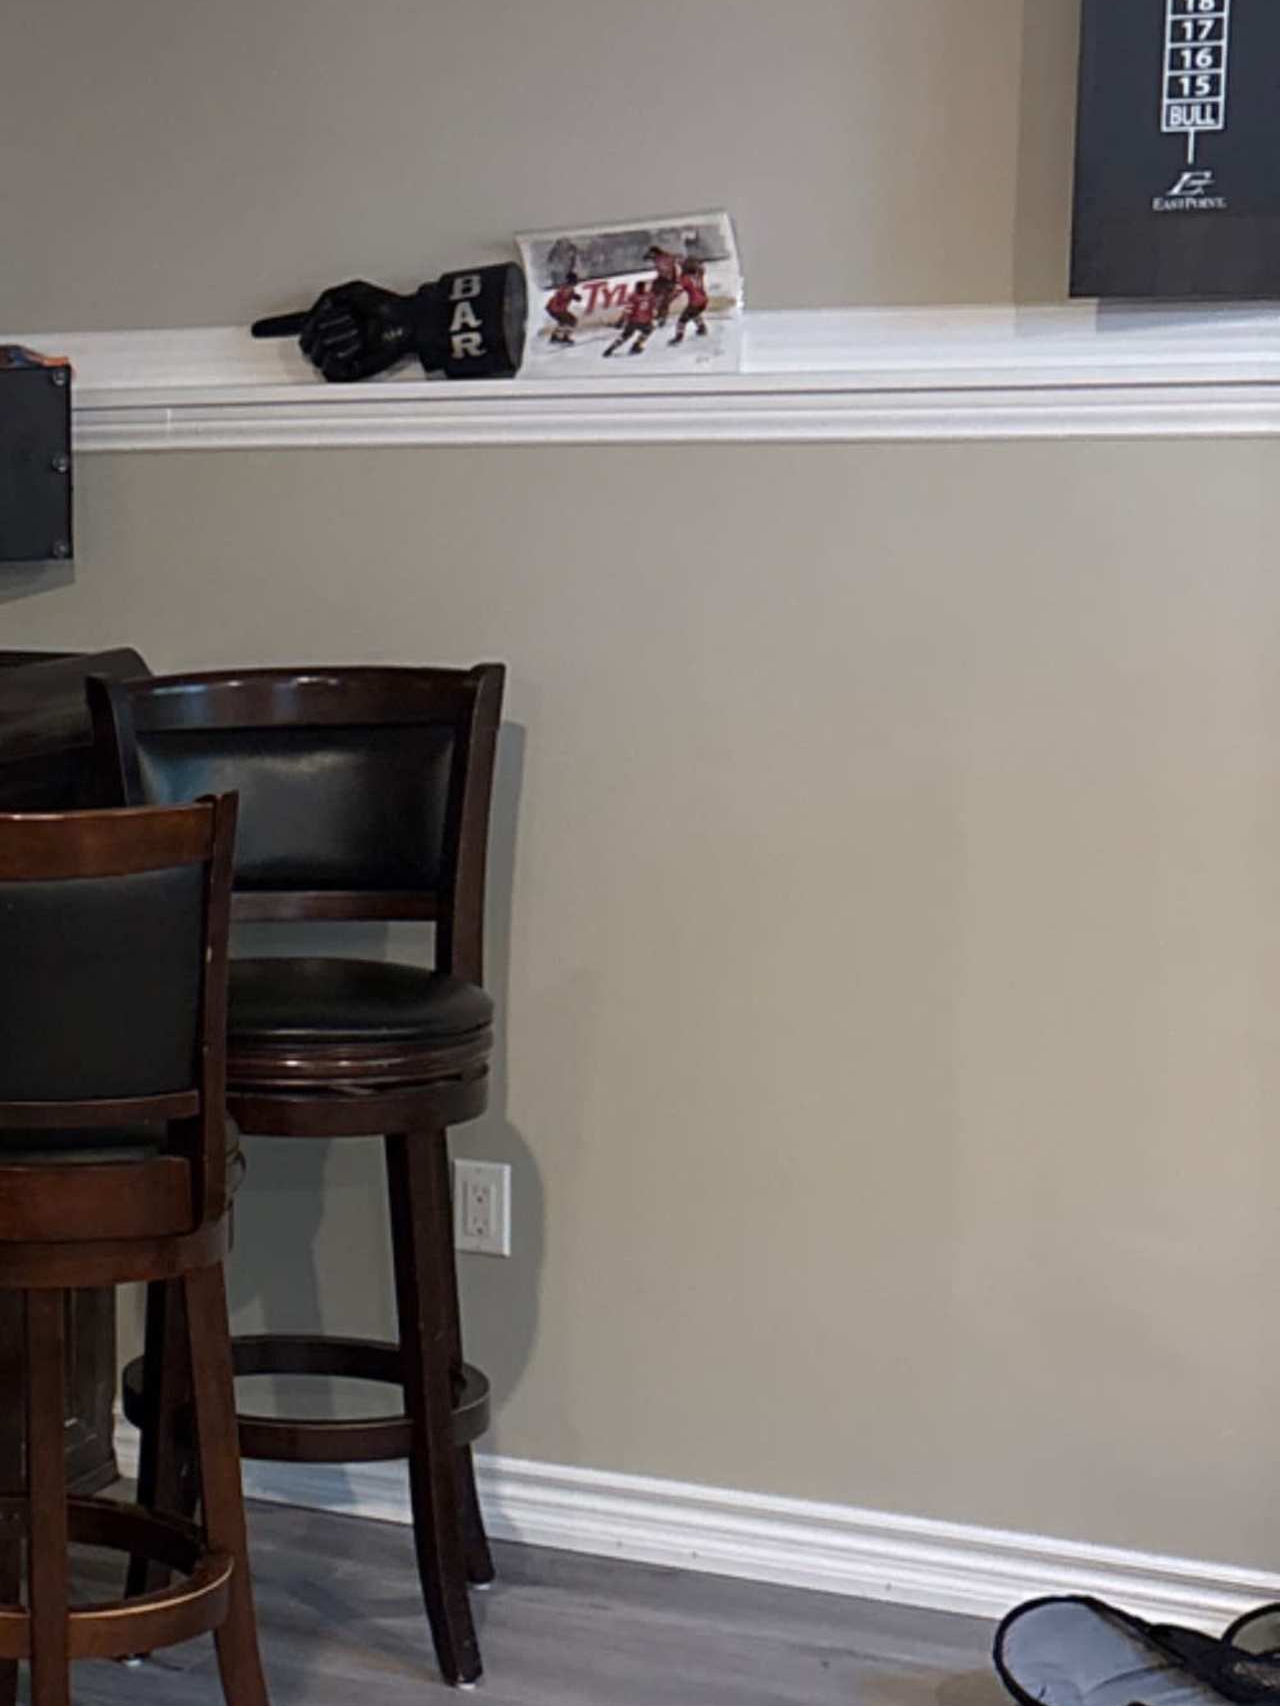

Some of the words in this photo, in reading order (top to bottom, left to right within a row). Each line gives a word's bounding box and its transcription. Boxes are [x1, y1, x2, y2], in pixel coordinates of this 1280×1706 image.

[1182, 20, 1215, 41] 17
[1180, 48, 1214, 69] 16
[1179, 76, 1211, 97] 15
[1169, 104, 1215, 126] BULL
[449, 276, 487, 360] BAR
